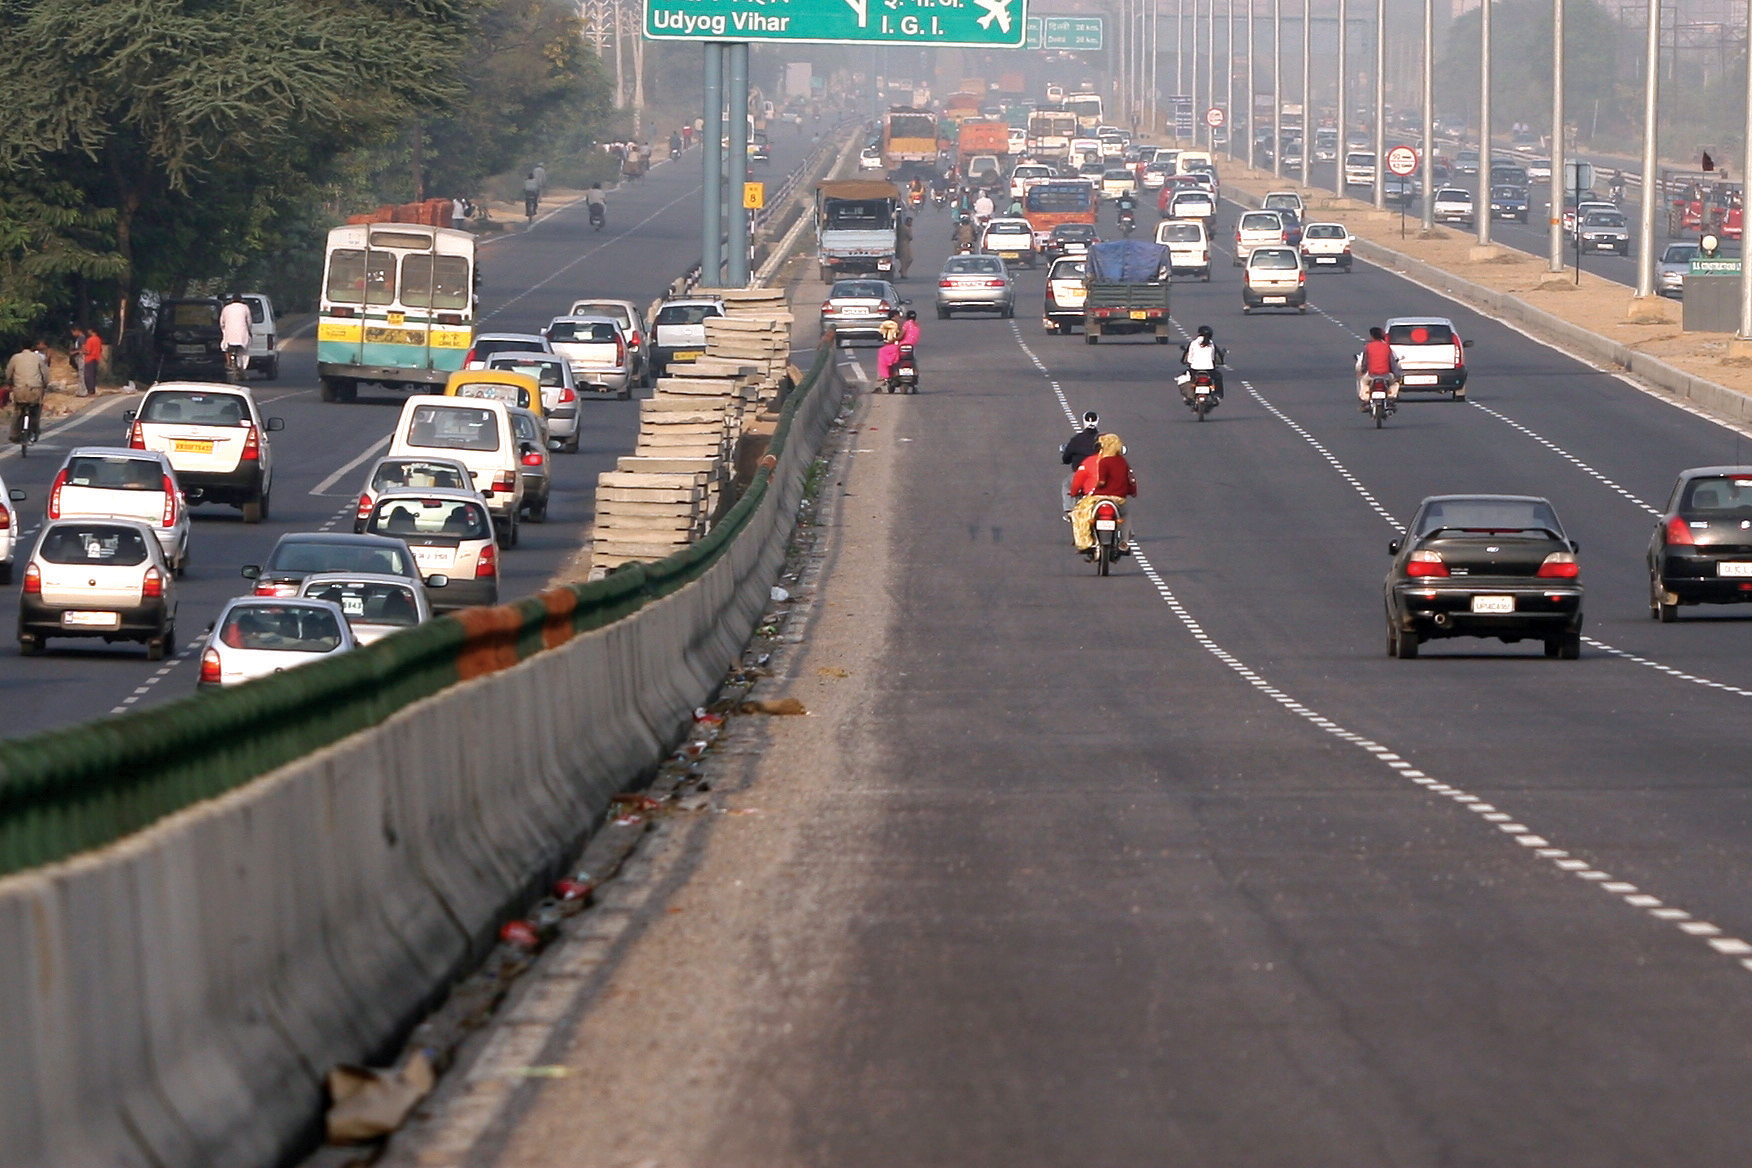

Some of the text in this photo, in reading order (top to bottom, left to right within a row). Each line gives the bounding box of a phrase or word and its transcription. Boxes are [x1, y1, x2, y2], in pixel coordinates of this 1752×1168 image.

[653, 9, 791, 35] Udyog Vihar
[750, 193, 757, 203] 8
